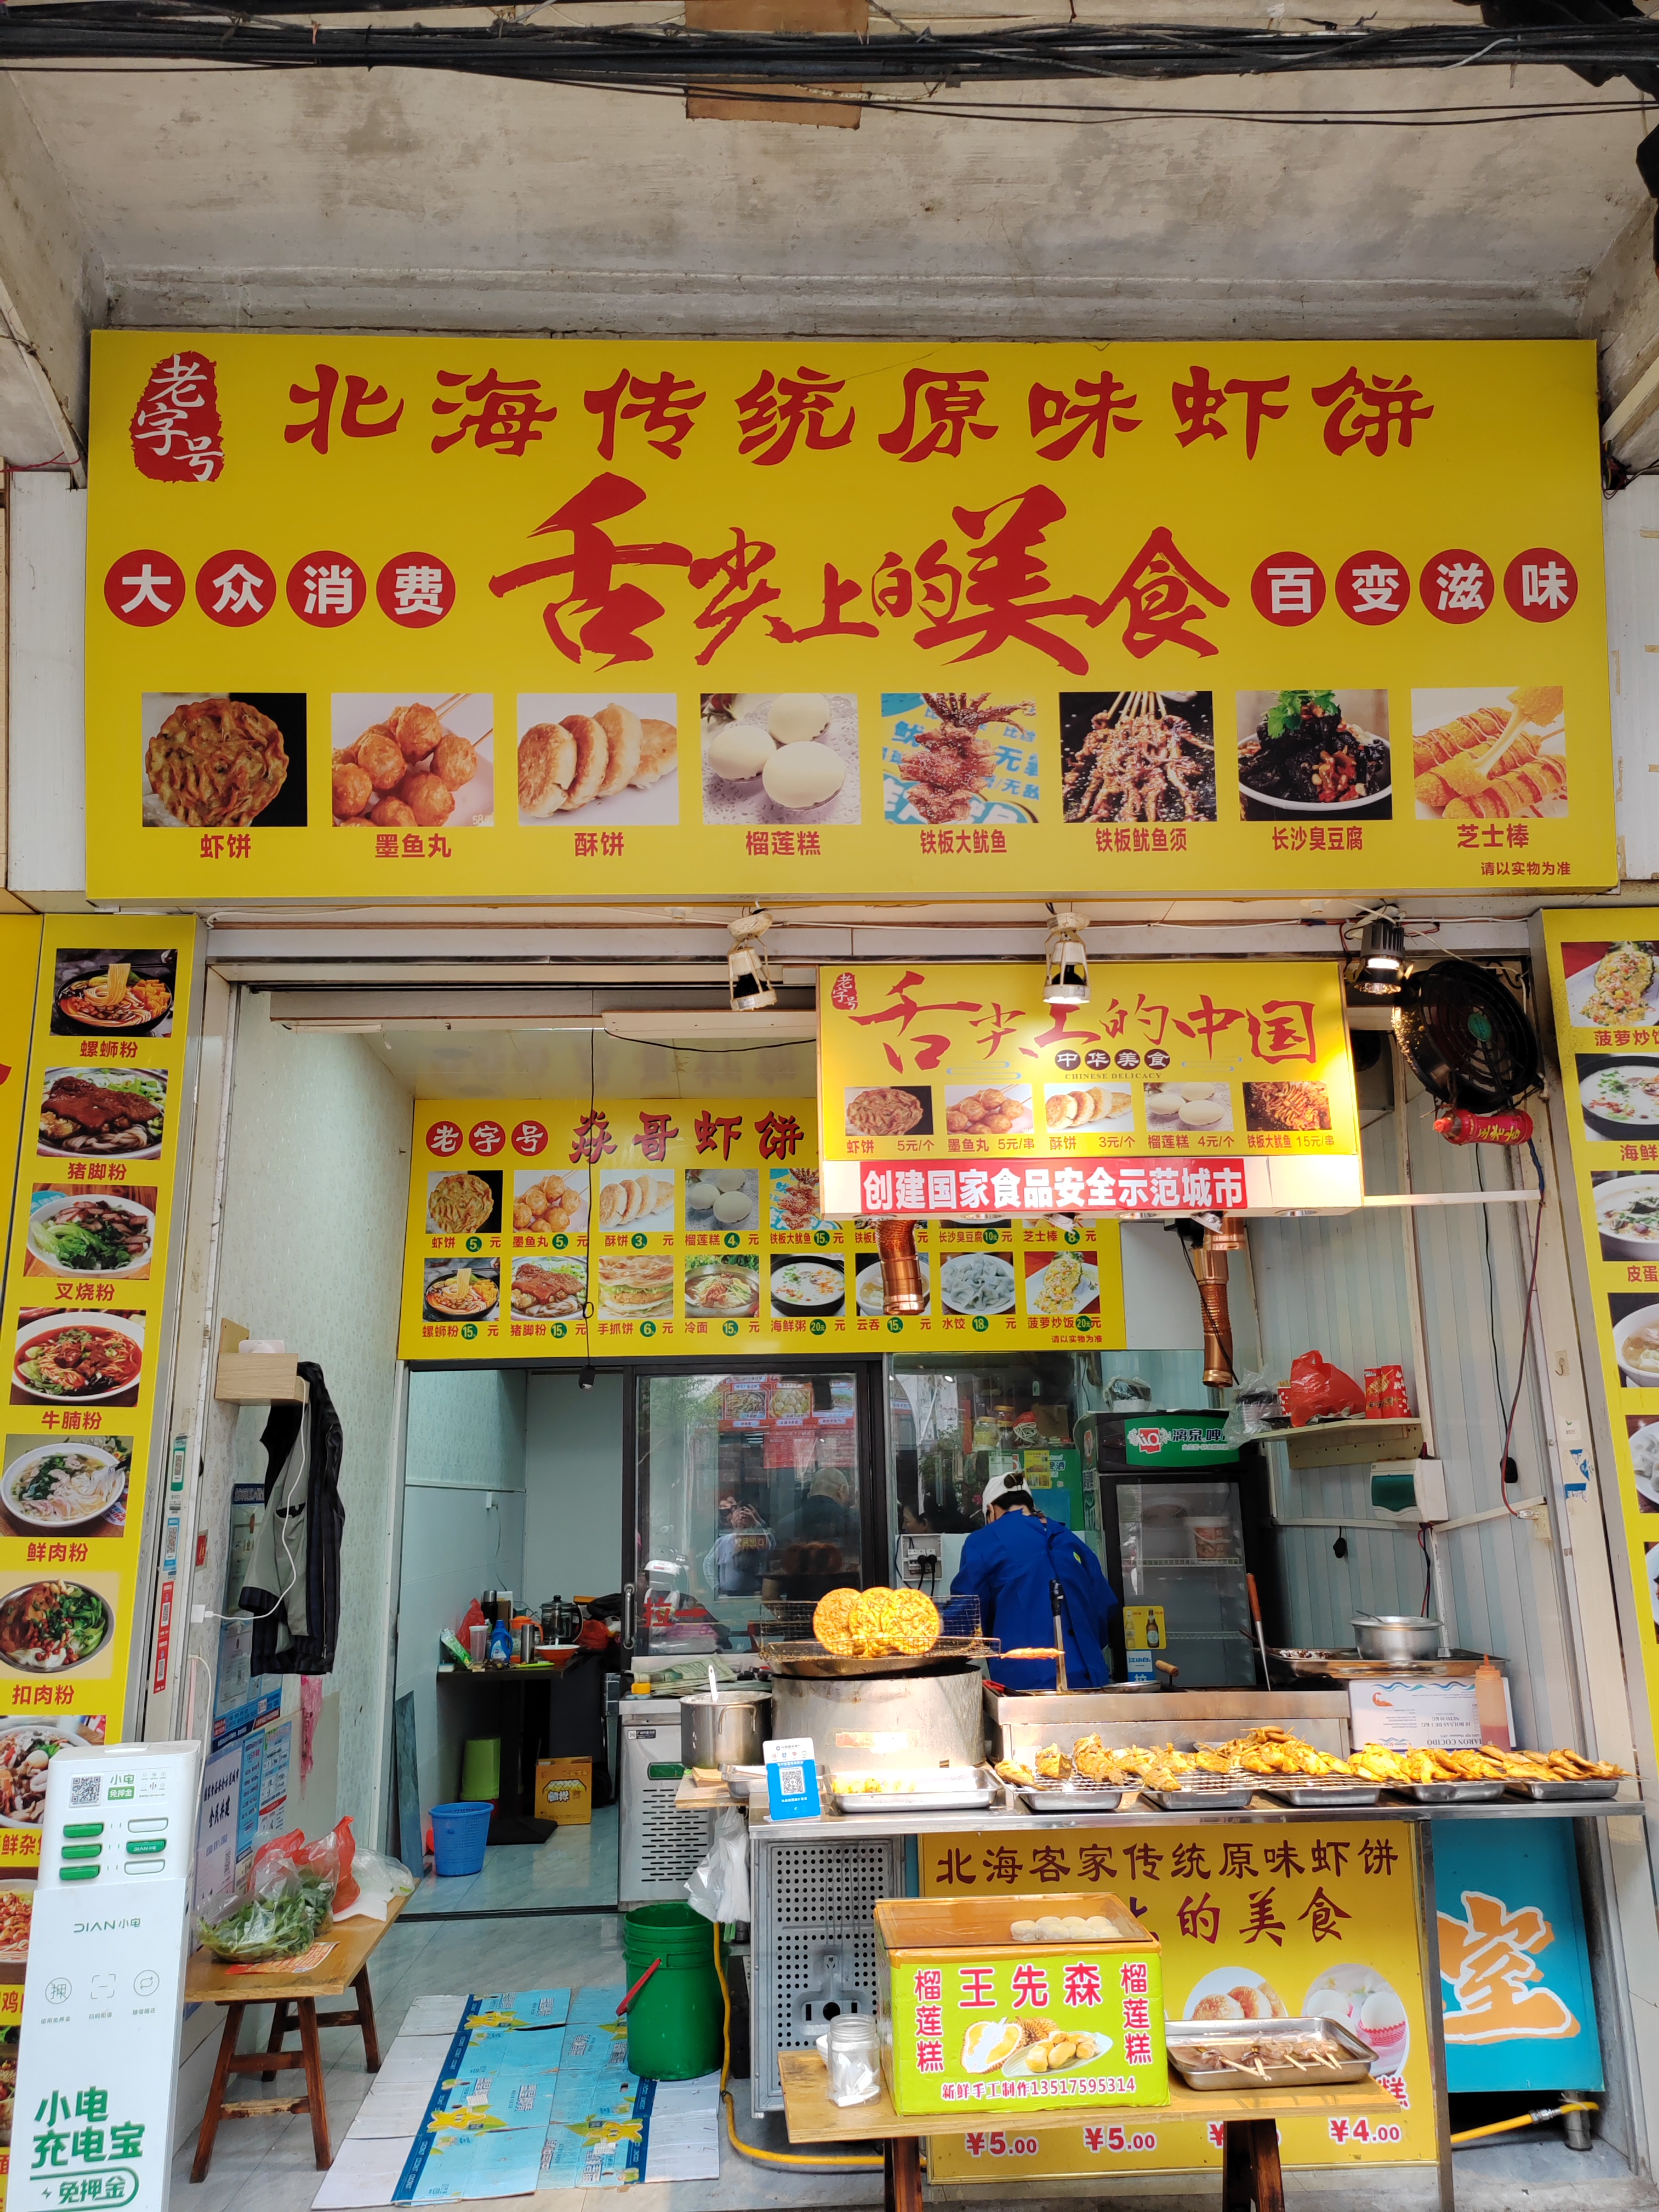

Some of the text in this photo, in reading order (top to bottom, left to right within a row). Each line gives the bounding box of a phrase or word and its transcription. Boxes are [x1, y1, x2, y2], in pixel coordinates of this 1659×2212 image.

[135, 354, 225, 482] 老字号
[285, 363, 1435, 466] 北海传统原味虾饼
[488, 471, 1231, 677] 舌尖上的美食
[120, 563, 444, 616] 大众消费
[1267, 561, 1570, 614] 百变滋味
[375, 833, 453, 859] 墨鱼丸
[575, 832, 625, 858] 酥饼
[746, 831, 821, 856] 榴莲糕
[920, 829, 1008, 854] 铁板大鱿鱼
[1096, 827, 1188, 852] 铁板鱿鱼须
[1272, 826, 1364, 851] 长沙臭豆腐
[1457, 824, 1530, 849] 芝士棒
[200, 834, 252, 860] 虾饼
[1481, 861, 1571, 876] 请以实物为准
[832, 973, 858, 1010] 老字号
[848, 970, 1317, 1074] 舌尖上的中国
[79, 1041, 138, 1058] 螺蛳粉
[1057, 1051, 1170, 1068] 中华美食
[430, 1124, 544, 1152] 老字号
[846, 1139, 935, 1154] 虾饼 5元/个
[947, 1137, 1035, 1153] 墨鱼丸 5元/串
[1049, 1135, 1136, 1151] 酥饼 3元/个
[1147, 1134, 1235, 1149] 榴莲糕 4元/个
[1246, 1134, 1335, 1149] 铁板大鱿鱼 15元/串
[68, 1162, 127, 1181] 猪脚粉
[862, 1166, 1243, 1211] 创建国家食品安全示范城市
[431, 1236, 456, 1249] 虾饼
[490, 1237, 502, 1248] 元
[512, 1235, 549, 1248] 墨鱼丸
[577, 1235, 589, 1247] 元
[604, 1235, 629, 1247] 酥饼
[663, 1234, 675, 1246] 元
[684, 1233, 721, 1246] 榴莲糕
[748, 1233, 760, 1245] 元
[770, 1232, 812, 1244] 铁板大鱿鱼
[833, 1232, 845, 1244] 元
[917, 1231, 929, 1243] 元
[939, 1230, 983, 1243] 长沙臭豆腐
[1001, 1230, 1013, 1243] 元
[1023, 1230, 1058, 1243] 芝士棒
[1085, 1230, 1097, 1242] 元
[55, 1283, 116, 1302] 叉烧粉
[422, 1325, 460, 1338] 螺蛳粉
[487, 1324, 499, 1337] 元
[510, 1324, 547, 1337] 猪脚粉
[575, 1323, 587, 1336] 元
[597, 1323, 634, 1336] 手抓饼
[662, 1321, 674, 1334] 元
[684, 1321, 709, 1334] 冷面
[748, 1321, 760, 1333] 元
[770, 1319, 807, 1332] 海鲜粥
[834, 1319, 846, 1331] 元
[857, 1319, 880, 1331] 云吞
[920, 1318, 932, 1330] 元
[942, 1318, 966, 1330] 水饺
[1006, 1317, 1017, 1329] 元
[1027, 1317, 1075, 1329] 菠萝炒饭
[1091, 1316, 1102, 1328] 元
[1051, 1334, 1103, 1343] 请以实物为准
[41, 1411, 103, 1431] 牛腩粉
[26, 1542, 89, 1563] 鲜肉粉
[643, 1597, 673, 1628] 拉
[12, 1684, 75, 1705] 扣肉粉
[110, 1773, 134, 1785] 小电
[109, 1789, 133, 1798] 免押金
[936, 1838, 1399, 1885] 北海客家传统原味虾饼
[73, 1917, 141, 1933] DIAN 小电
[959, 1961, 1102, 2009] 王先森
[914, 1970, 944, 2073] 榴莲糕
[1120, 1963, 1152, 2065] 榴莲糕
[34, 2086, 109, 2128] 小电
[1083, 2125, 1157, 2153] ¥5.00
[1329, 2117, 1401, 2144] ¥4.00
[31, 2120, 145, 2169] 充电宝
[965, 2131, 1038, 2157] ¥5.00
[58, 2176, 126, 2204] 免押金
